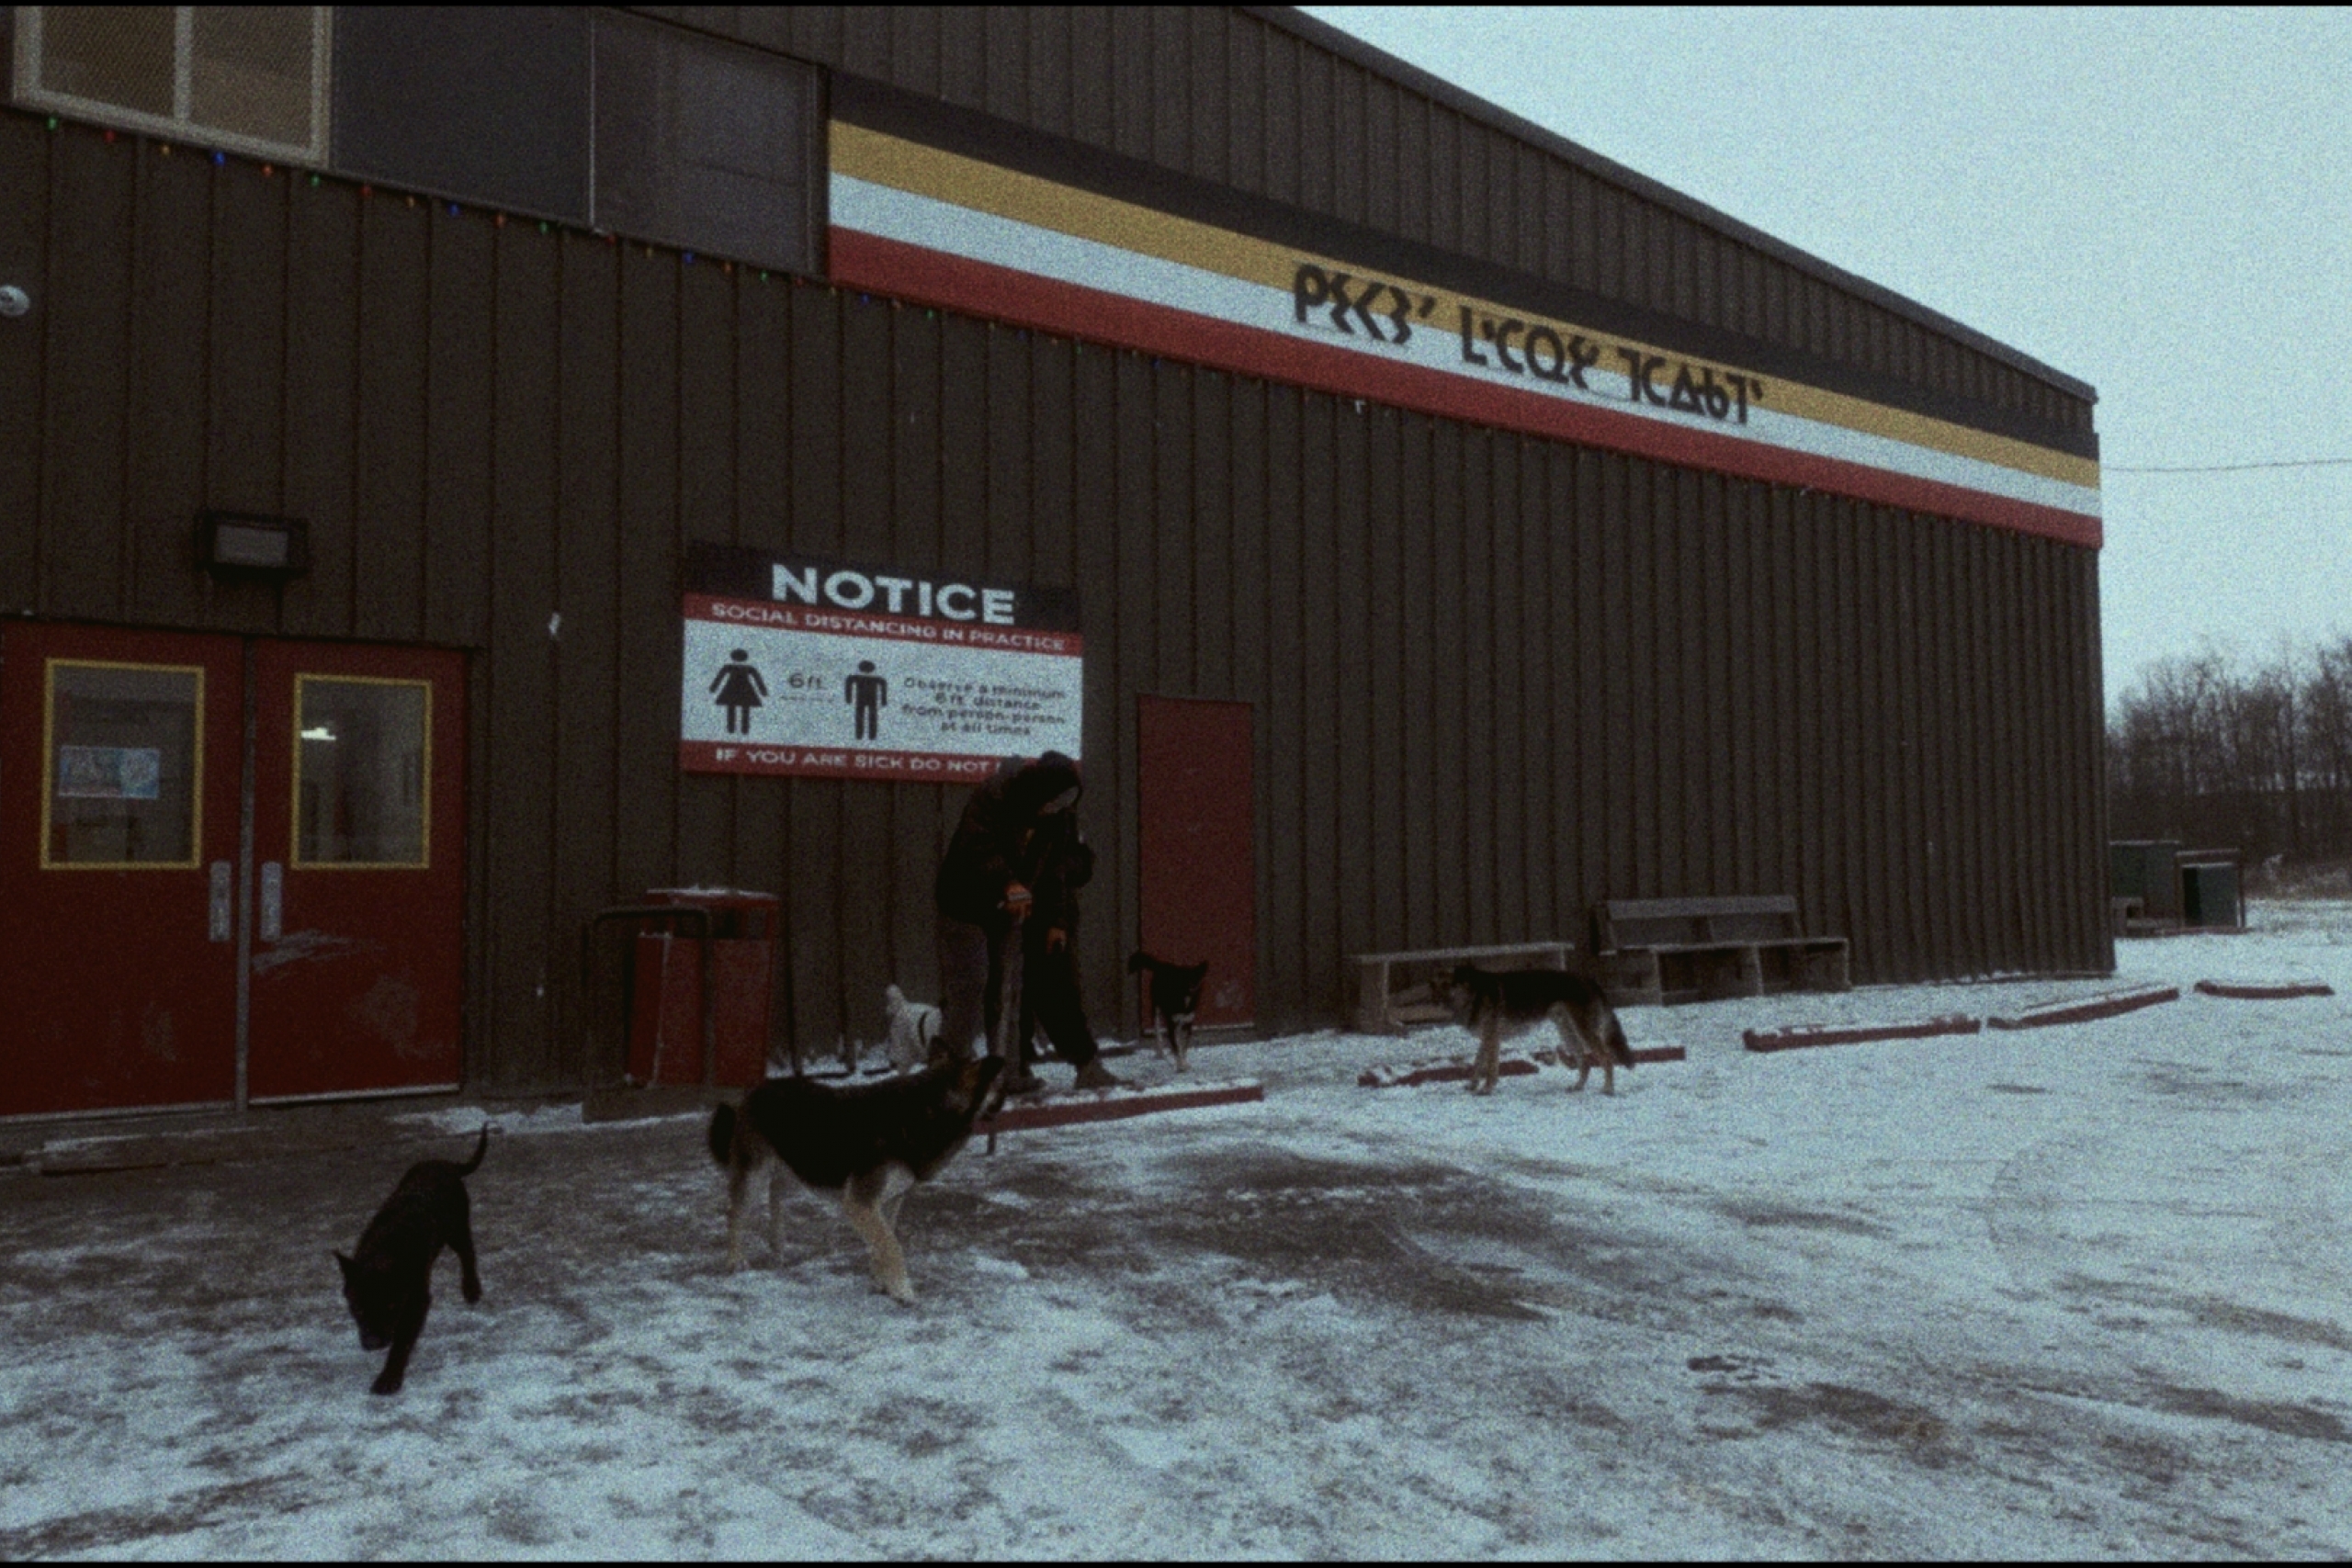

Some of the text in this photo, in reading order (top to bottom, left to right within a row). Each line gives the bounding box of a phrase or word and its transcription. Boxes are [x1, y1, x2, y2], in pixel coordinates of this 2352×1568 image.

[771, 563, 1015, 626] NOTICE
[711, 602, 1065, 651] SOCIAL DISTANCING IN PRACTICE
[903, 677, 1067, 699] Observe a minimum
[901, 703, 944, 716] from
[973, 696, 1040, 711] distance
[941, 721, 1032, 736] at all times
[716, 747, 739, 761] IF
[746, 750, 796, 765] YOU
[802, 752, 847, 767] ARE
[855, 754, 904, 769] SICK
[910, 757, 942, 772] DO
[946, 760, 990, 773] NOT
